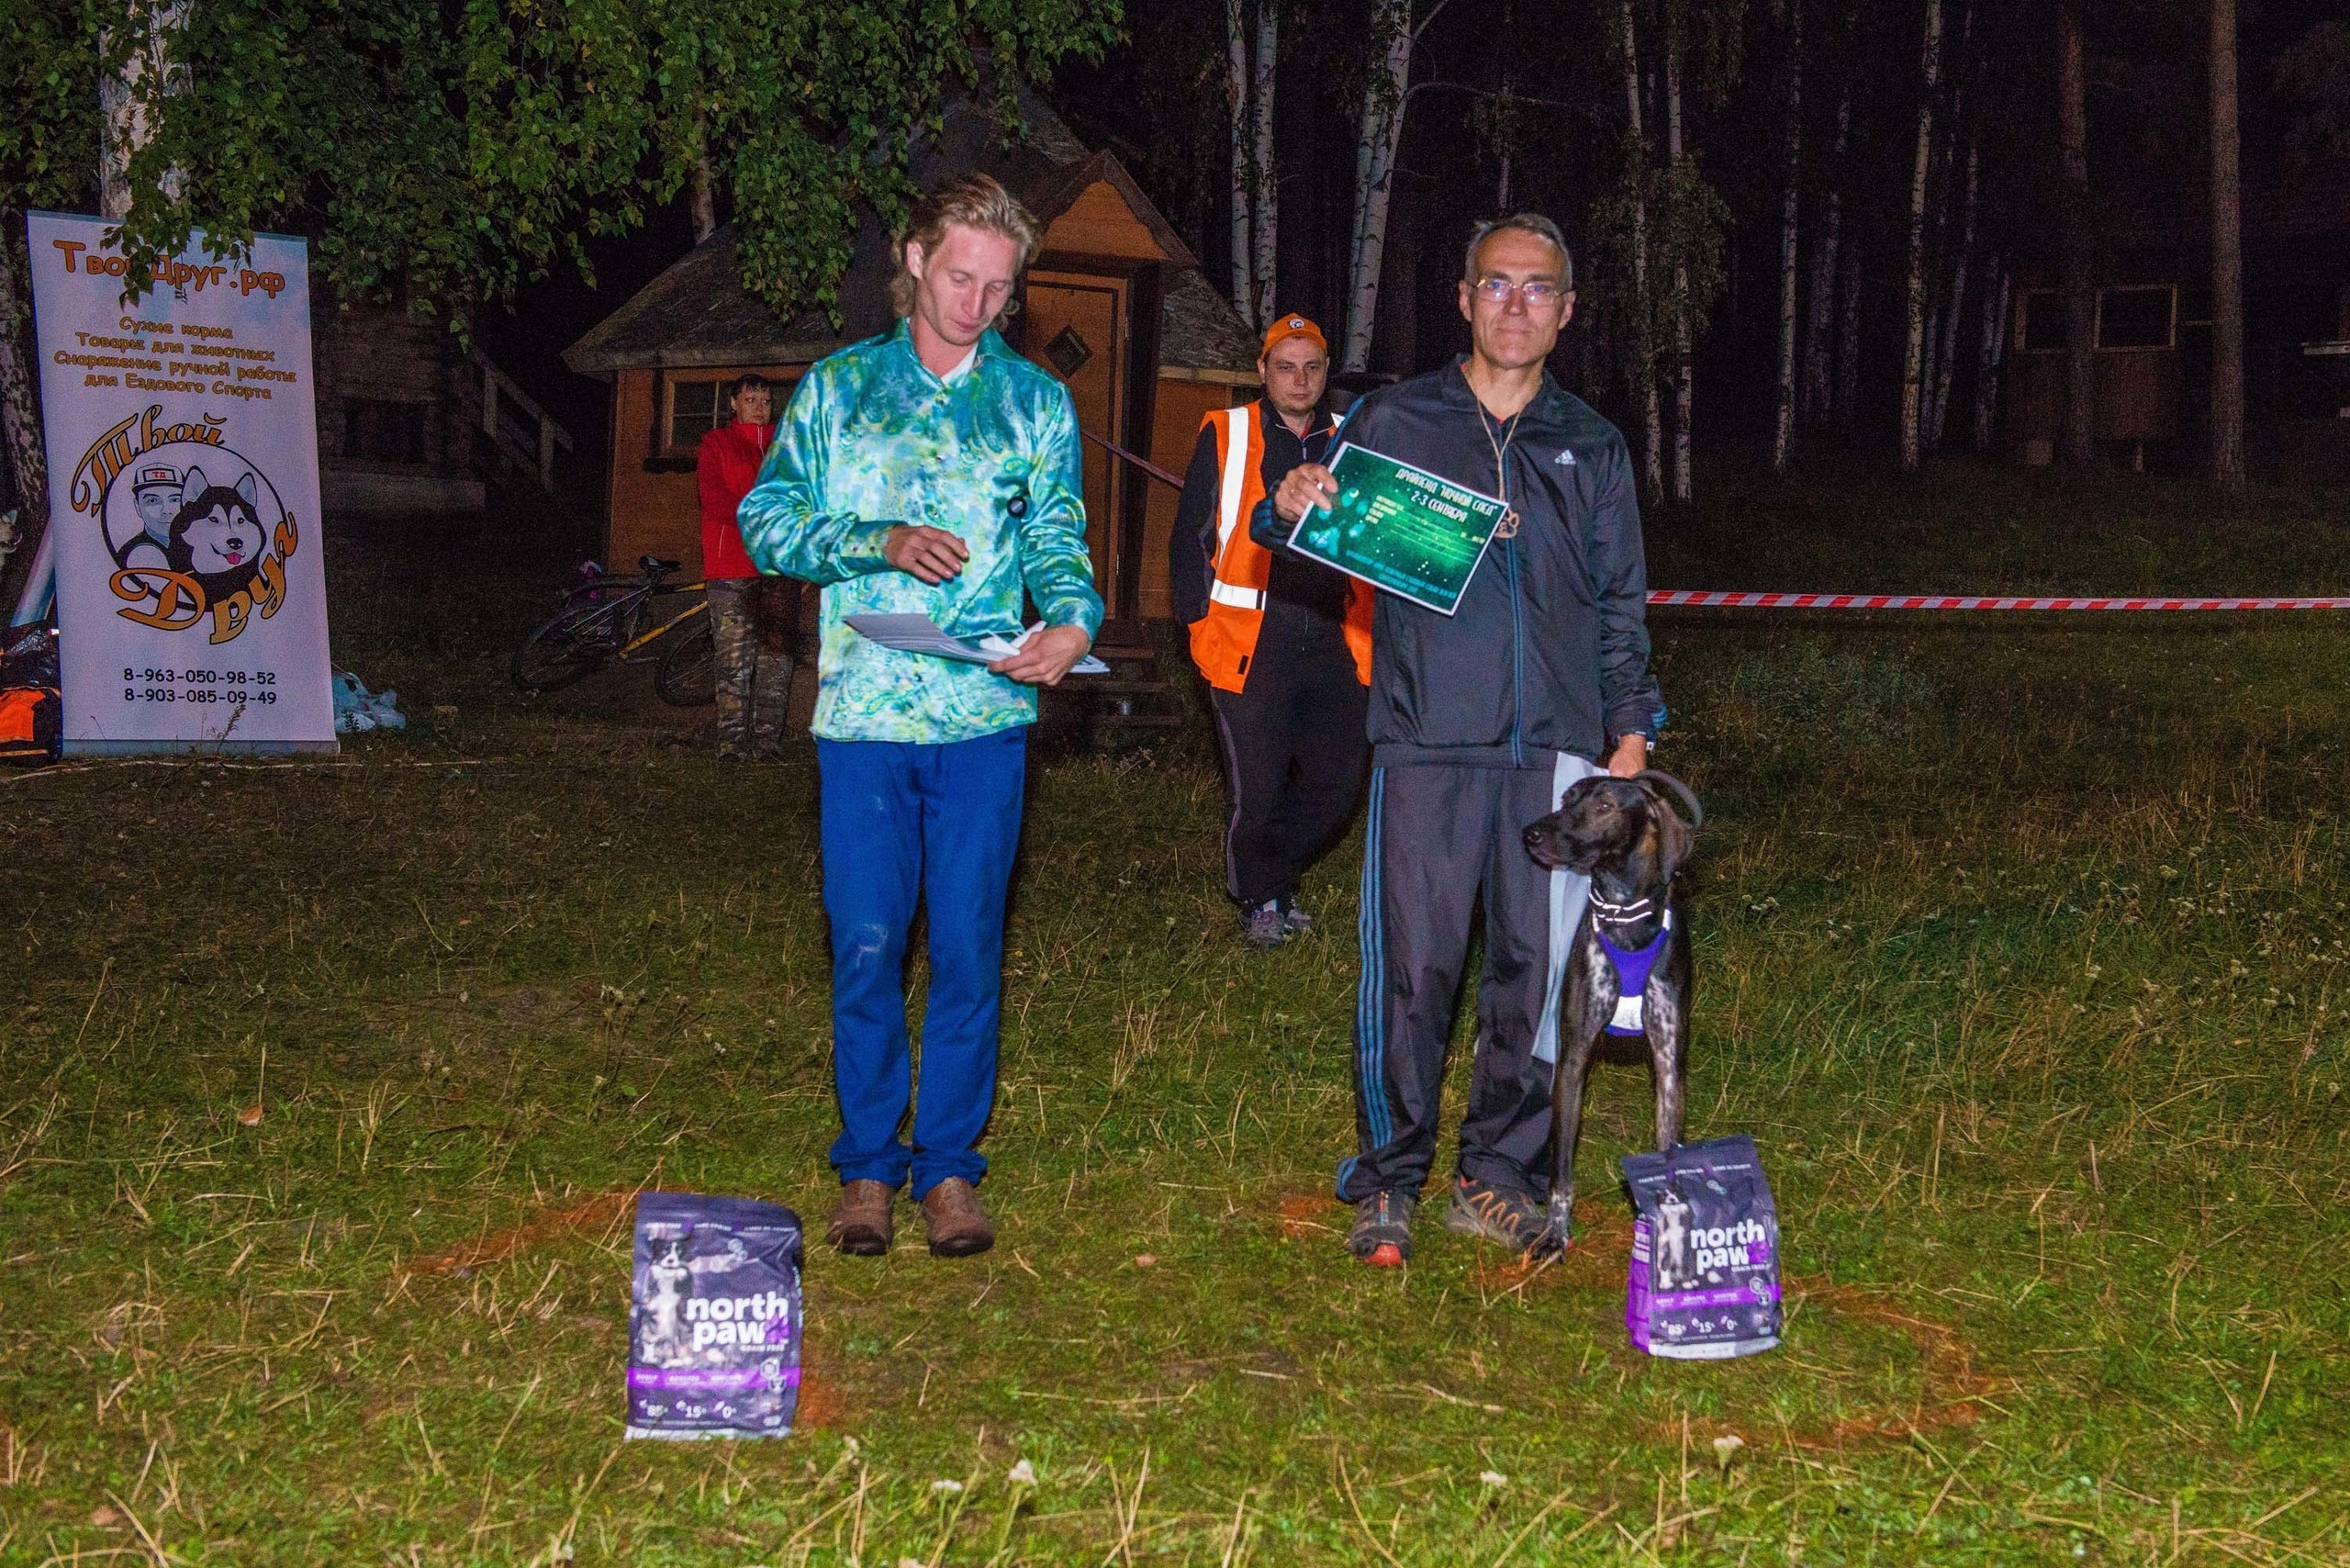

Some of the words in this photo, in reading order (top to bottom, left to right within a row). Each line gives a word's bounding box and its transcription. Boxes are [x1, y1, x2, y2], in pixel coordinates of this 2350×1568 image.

[52, 240, 285, 299] ТвоДруг.рф
[118, 316, 174, 334] Сухие
[181, 322, 233, 340] корма
[74, 331, 145, 353] Товары
[151, 340, 184, 354] для
[190, 342, 274, 362] животных
[54, 350, 162, 372] Снаряжение
[169, 357, 230, 376] ручной
[237, 364, 297, 383] работы
[84, 372, 118, 386] для
[125, 373, 206, 394] Ездового
[212, 381, 272, 401] Спорта
[71, 404, 227, 519] Твой
[1411, 490, 1428, 506] 2-3
[123, 667, 276, 685] 8-963-050-98-52
[124, 688, 276, 705] 8-903-085-09-49
[1691, 1218, 1766, 1249] north
[1696, 1244, 1749, 1275] paw
[686, 1291, 789, 1321] north
[692, 1321, 766, 1352] paw
